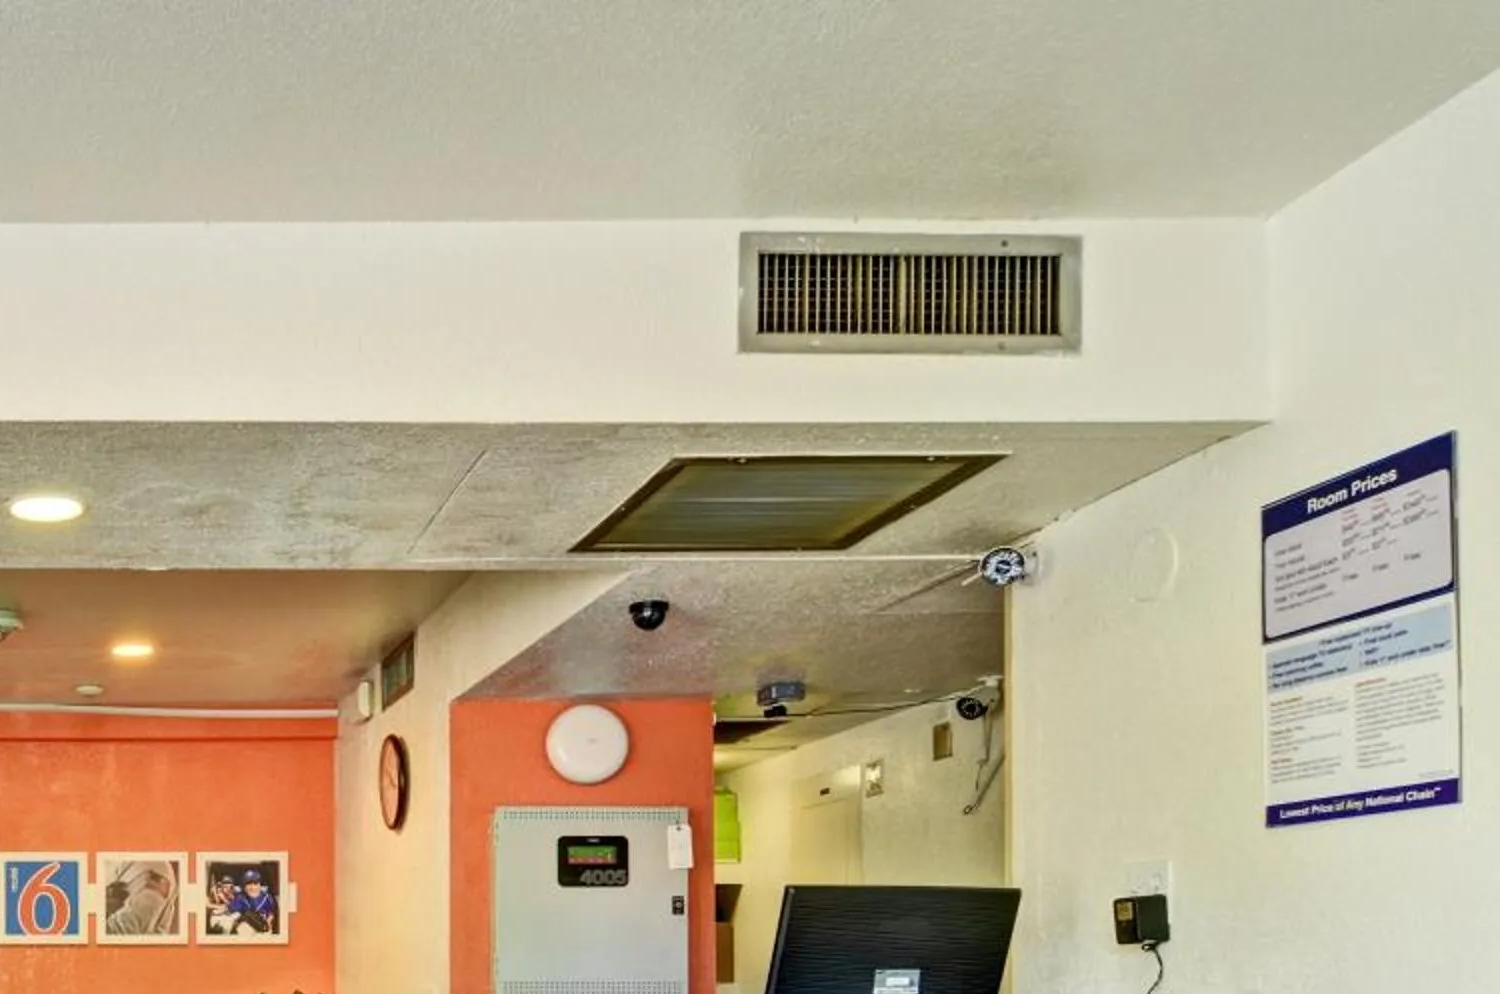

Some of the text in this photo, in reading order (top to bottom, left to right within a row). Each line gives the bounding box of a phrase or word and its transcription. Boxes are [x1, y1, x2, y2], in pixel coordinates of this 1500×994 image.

[1306, 468, 1398, 515] Room Prices
[17, 861, 71, 936] 6
[579, 868, 628, 885] 4005
